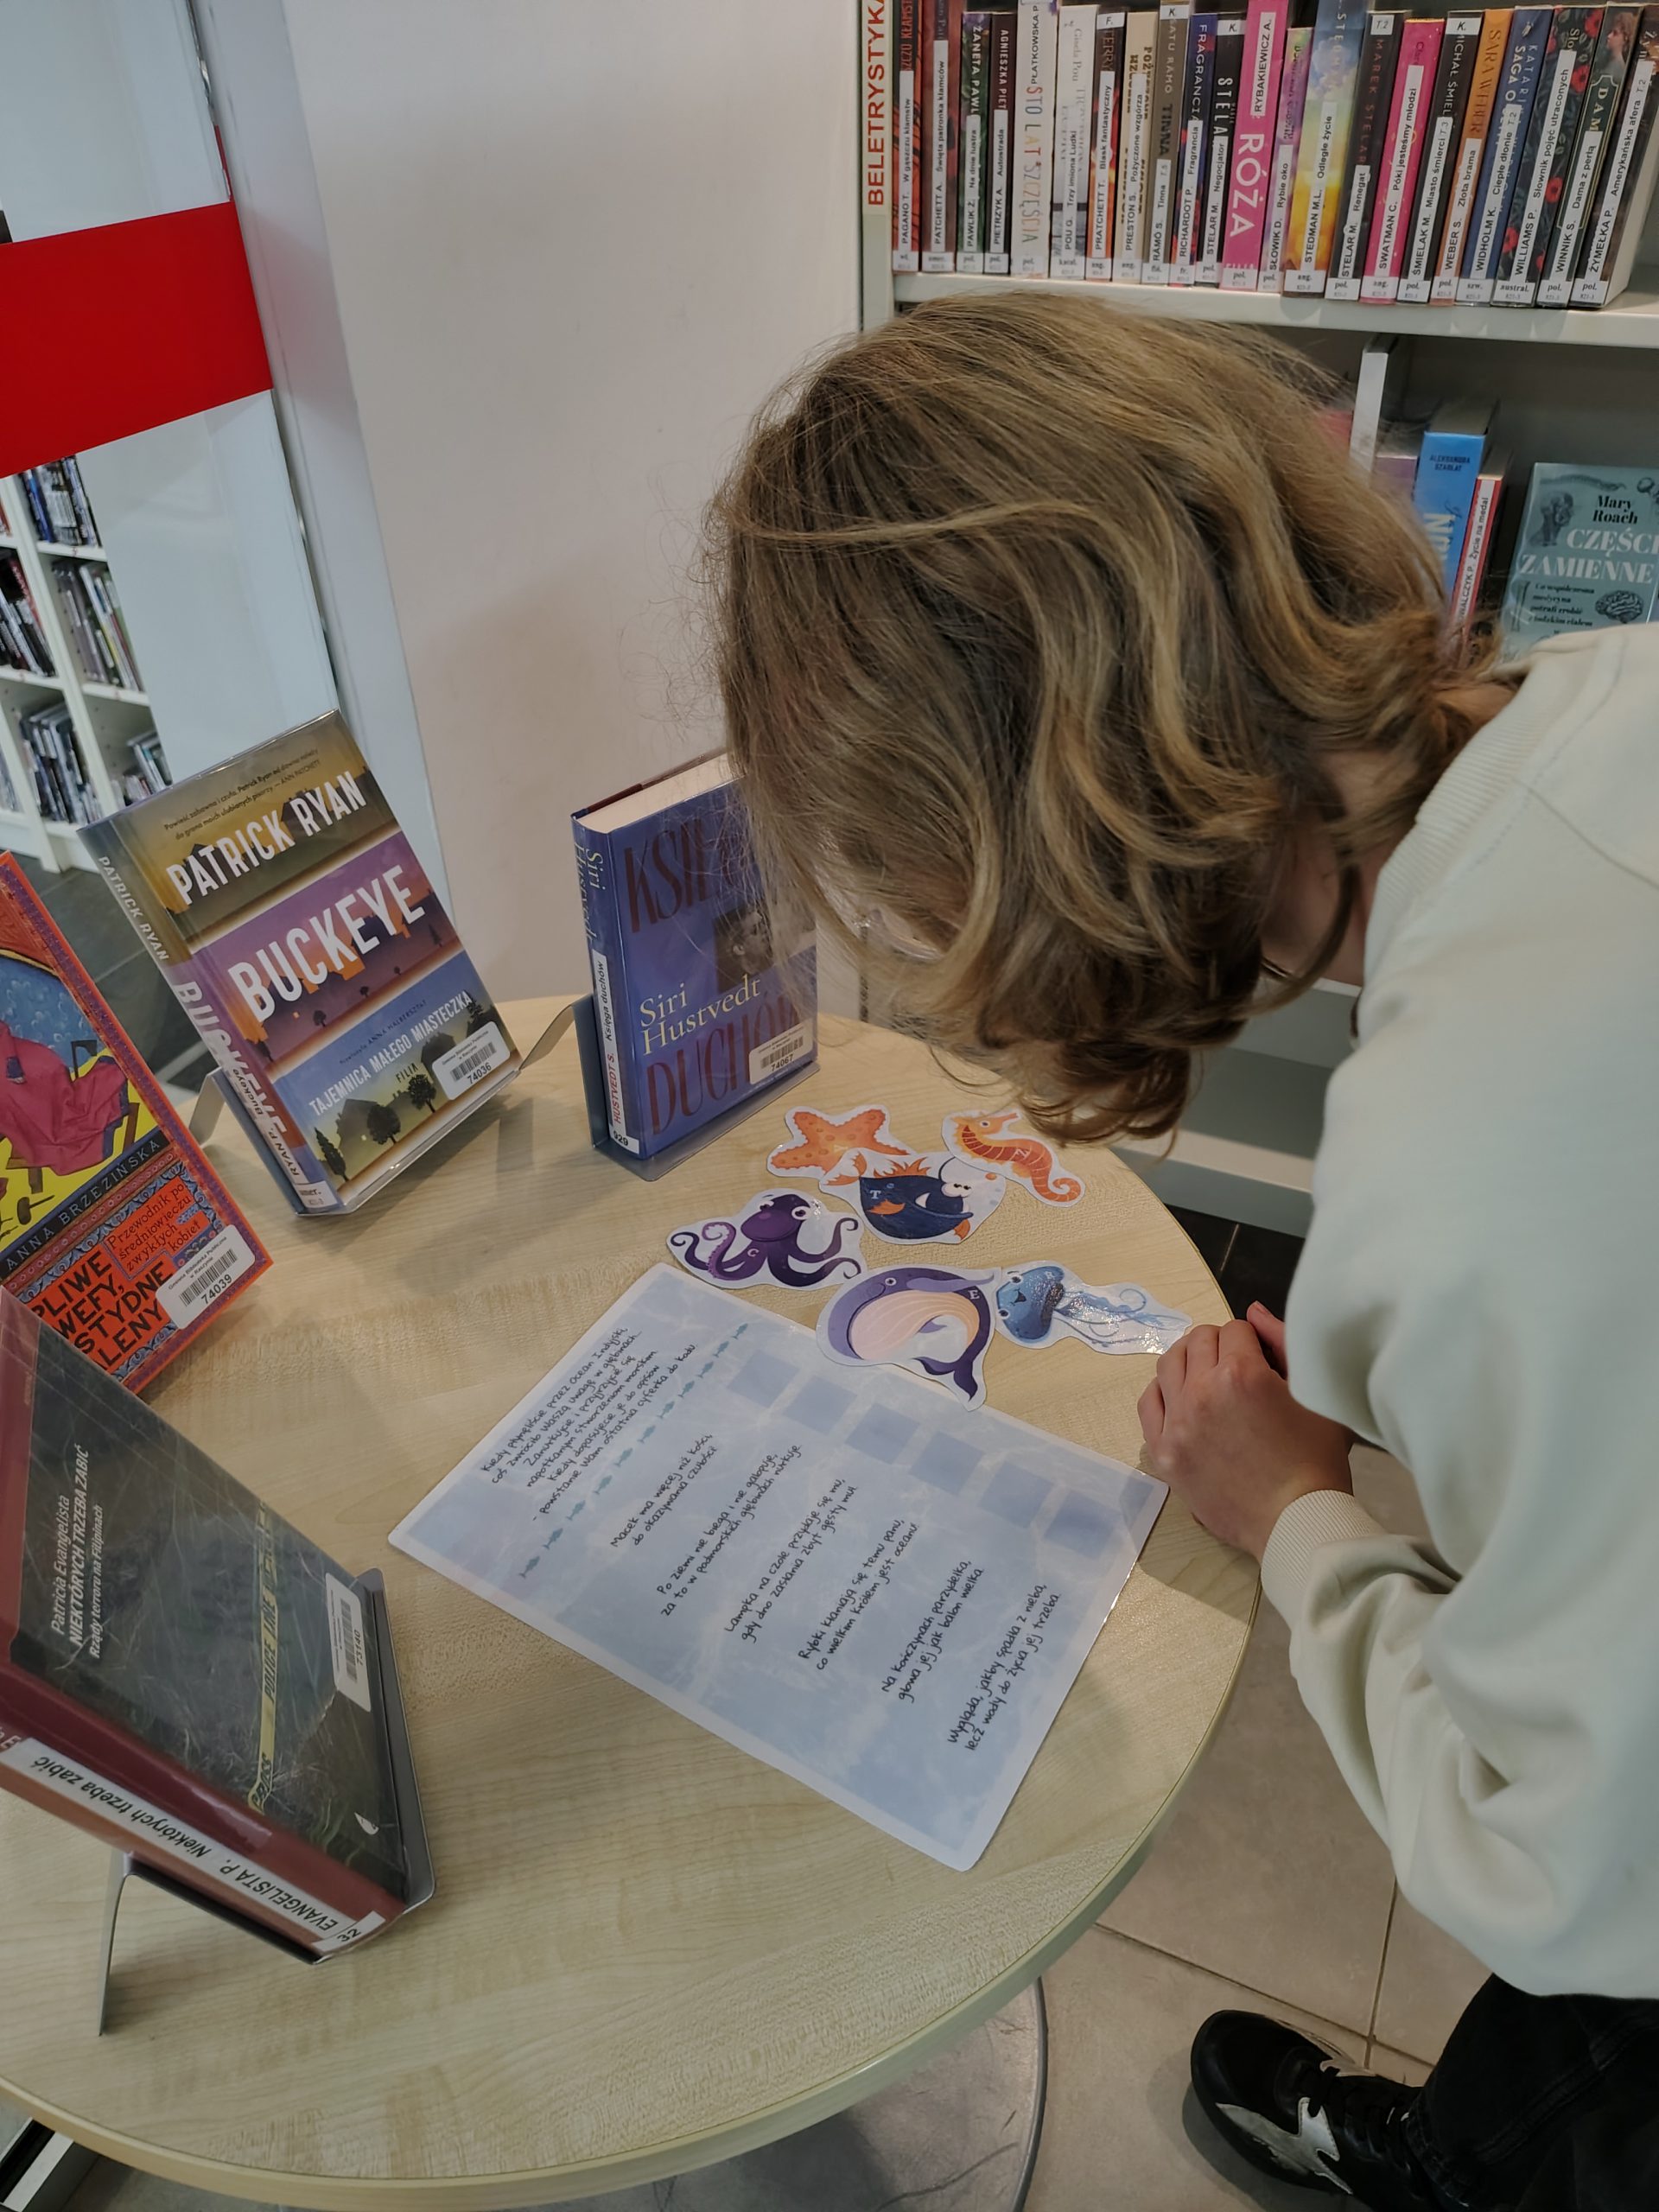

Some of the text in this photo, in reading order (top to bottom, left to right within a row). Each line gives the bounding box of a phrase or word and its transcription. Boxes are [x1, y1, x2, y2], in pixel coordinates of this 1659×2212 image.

[1000, 29, 1009, 85] AGNIESZKA
[1254, 18, 1272, 113] RYBAKIEWICZ A.
[1026, 86, 1043, 114] STO
[1405, 88, 1417, 122] młodzi
[1395, 124, 1412, 168] jesteśmy
[1432, 138, 1446, 175] śmierci
[1463, 149, 1476, 181] brama
[1180, 199, 1193, 257] RICHARDOT
[1187, 126, 1199, 175] Fragrancia
[1230, 133, 1268, 238] RÓŻA
[1277, 184, 1287, 208] Rybie
[1281, 162, 1289, 181] oko
[1304, 213, 1319, 263] STEDMAN
[1323, 115, 1333, 140] życie
[1393, 169, 1403, 191] Póki
[1426, 176, 1439, 208] Miasto
[1458, 183, 1470, 207] Złota
[1515, 68, 1569, 276] WILLIAMS P. Słownik pojęć utraconych
[1587, 220, 1611, 273] ŻYMEŁKA
[1601, 207, 1614, 220] P.
[1610, 128, 1633, 197] Amerykańska
[1627, 99, 1642, 126] afera
[1096, 193, 1106, 251] PRATCHETT
[1207, 216, 1218, 255] STELAR
[1214, 143, 1225, 193] Negocjator
[1475, 131, 1512, 271] WIDHOLM K. Ciepłe dłonie
[1554, 233, 1573, 273] WINNIK
[1565, 219, 1576, 231] S.
[1572, 181, 1586, 209] Dama
[1582, 144, 1597, 171] perłą
[1269, 231, 1281, 271] SŁOWIK
[1378, 215, 1394, 270] SWATMAN
[1411, 229, 1428, 276] ŚMIELAK
[1445, 231, 1459, 270] WEBER
[1479, 497, 1490, 523] medal
[1592, 509, 1638, 525] Roach
[1597, 494, 1633, 512] Mary
[1519, 553, 1656, 584] ZAMIENNE
[166, 809, 296, 906] PATRICK
[289, 770, 367, 837] RYAN
[587, 849, 607, 891] Siri
[98, 855, 169, 962] PATRICK RYAN
[227, 864, 426, 1024] BUCKEYE
[597, 960, 611, 1005] duchów
[639, 982, 688, 1028] Siri
[605, 1005, 614, 1042] Księga
[641, 973, 761, 1057] Hustvedt
[308, 1062, 372, 1117] TAJEMNICA
[369, 1033, 412, 1076] MAŁEGO
[410, 989, 474, 1043] MIASTECZKA
[395, 1061, 420, 1084] FILIA
[466, 1061, 493, 1085] 74036
[771, 1052, 794, 1072] 74067
[232, 1068, 264, 1115] Buckeye
[607, 1065, 622, 1124] HUSTVEDT
[274, 1142, 300, 1176] RYAN
[613, 1129, 629, 1147] 929
[6, 1141, 161, 1270] ANNA BRZEZIŃSKA
[107, 1182, 187, 1251] Przewodnik po
[119, 1195, 194, 1262] średniowieczu
[126, 1224, 179, 1273] zwykłych
[169, 1219, 203, 1254] kobiet
[200, 1273, 233, 1306] 74039
[96, 1301, 163, 1370] LENY
[67, 1442, 90, 1647] NIEKTÓRYCH TRZEBA ZABIĆ
[91, 1503, 105, 1559] Filipinach
[51, 1493, 72, 1636] Patricia Evangelista
[724, 1592, 759, 1632] Lampka
[758, 1576, 771, 1590] na
[768, 1550, 790, 1575] czole
[787, 1510, 822, 1549] przydaje
[817, 1495, 833, 1508] się
[741, 1620, 762, 1643] gdy
[755, 1600, 772, 1620] dno
[800, 1532, 823, 1556] zbyt
[820, 1503, 848, 1534] gęsty
[90, 1573, 103, 1619] terroru
[88, 1618, 104, 1660] Rządy
[353, 1629, 365, 1667] 73140
[880, 1675, 898, 1693] Na
[890, 1616, 939, 1673] kończynach
[898, 1668, 922, 1703] głowa
[919, 1650, 938, 1672] jej
[930, 1630, 943, 1655] jak
[937, 1602, 963, 1628] balon
[980, 1661, 1006, 1698] jakby
[1025, 1584, 1047, 1612] nieba,
[262, 1642, 276, 1703] POLICE
[964, 1726, 985, 1751] lecz
[982, 1696, 1007, 1725] wody
[997, 1680, 1011, 1694] do
[1004, 1649, 1029, 1677] życia
[1025, 1633, 1044, 1653] jej
[30, 1756, 339, 1933] EVANGELISTA P. Niektórych trzeba zabić
[336, 1927, 362, 1944] 32
